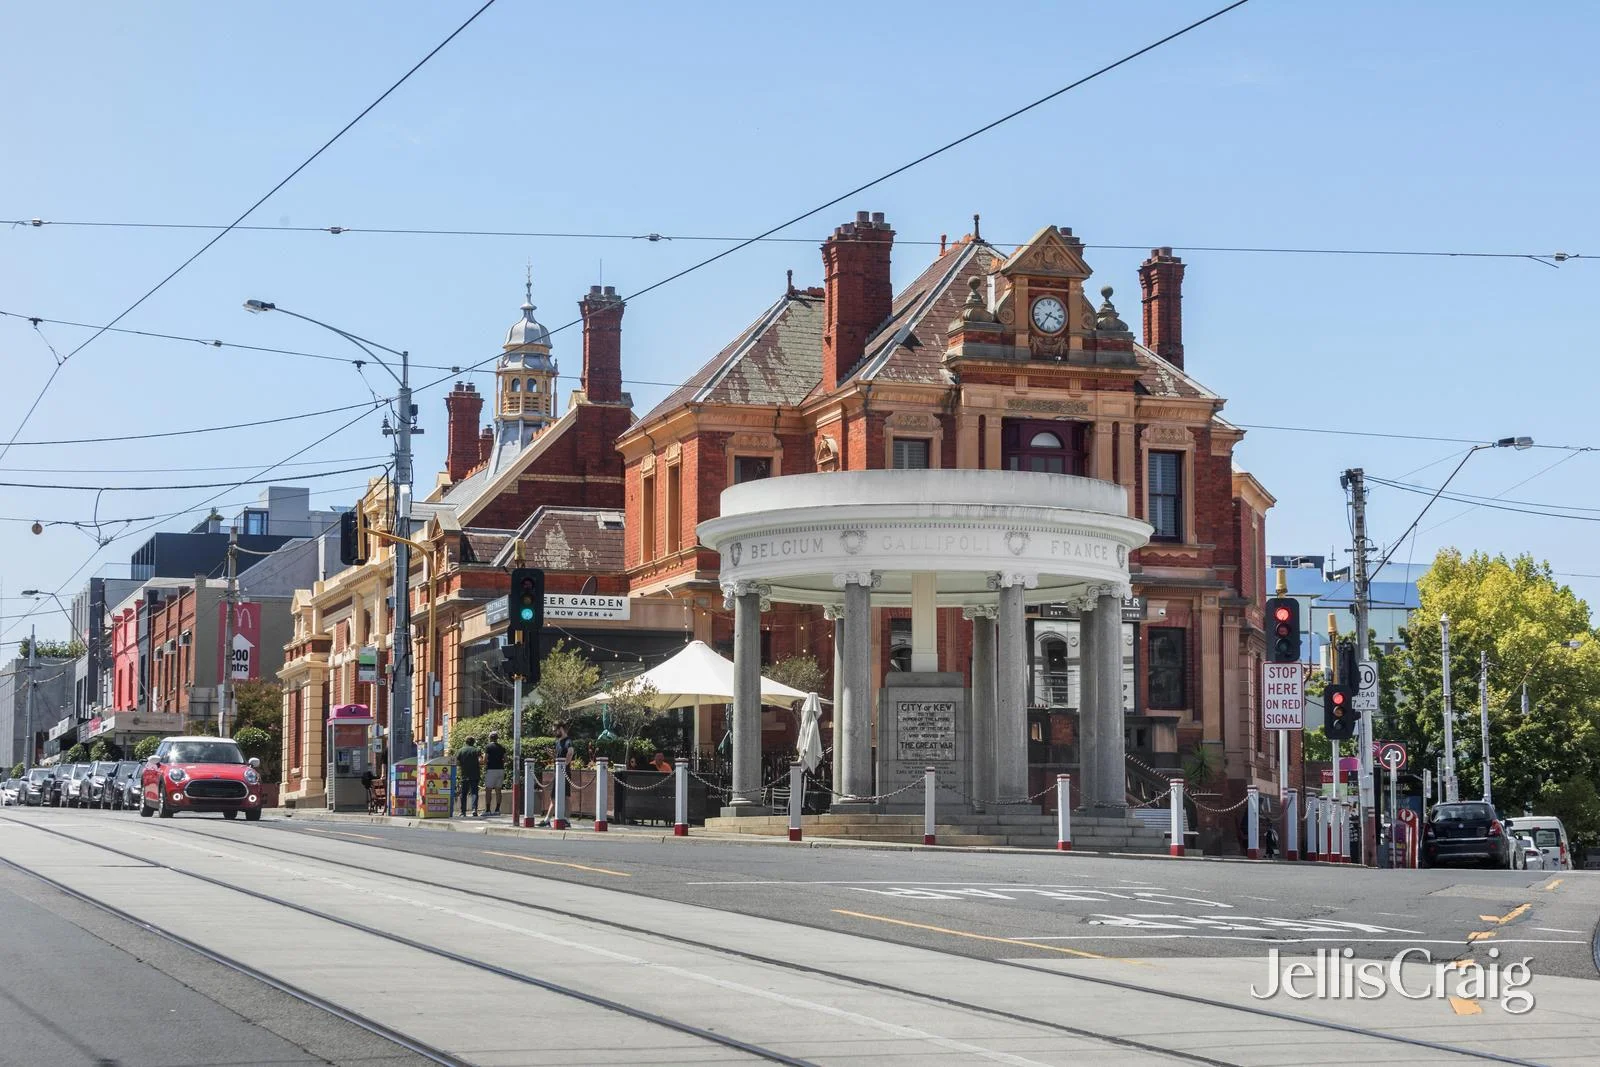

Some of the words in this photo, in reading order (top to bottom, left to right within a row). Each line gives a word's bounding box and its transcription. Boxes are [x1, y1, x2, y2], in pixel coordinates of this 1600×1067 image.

[751, 538, 824, 559] BELGIUM
[882, 535, 990, 551] GALLIPOLI
[1051, 540, 1108, 560] FRANCE
[544, 597, 565, 605] EER
[571, 597, 623, 607] GARDEN
[1268, 666, 1297, 679] STOP
[1361, 670, 1373, 683] 0
[1268, 683, 1298, 695] HERE
[901, 703, 922, 711] CITY
[933, 703, 952, 711] KEW
[1265, 699, 1279, 710] ON
[1281, 699, 1301, 710] RED
[1266, 713, 1301, 724] SIGNAL
